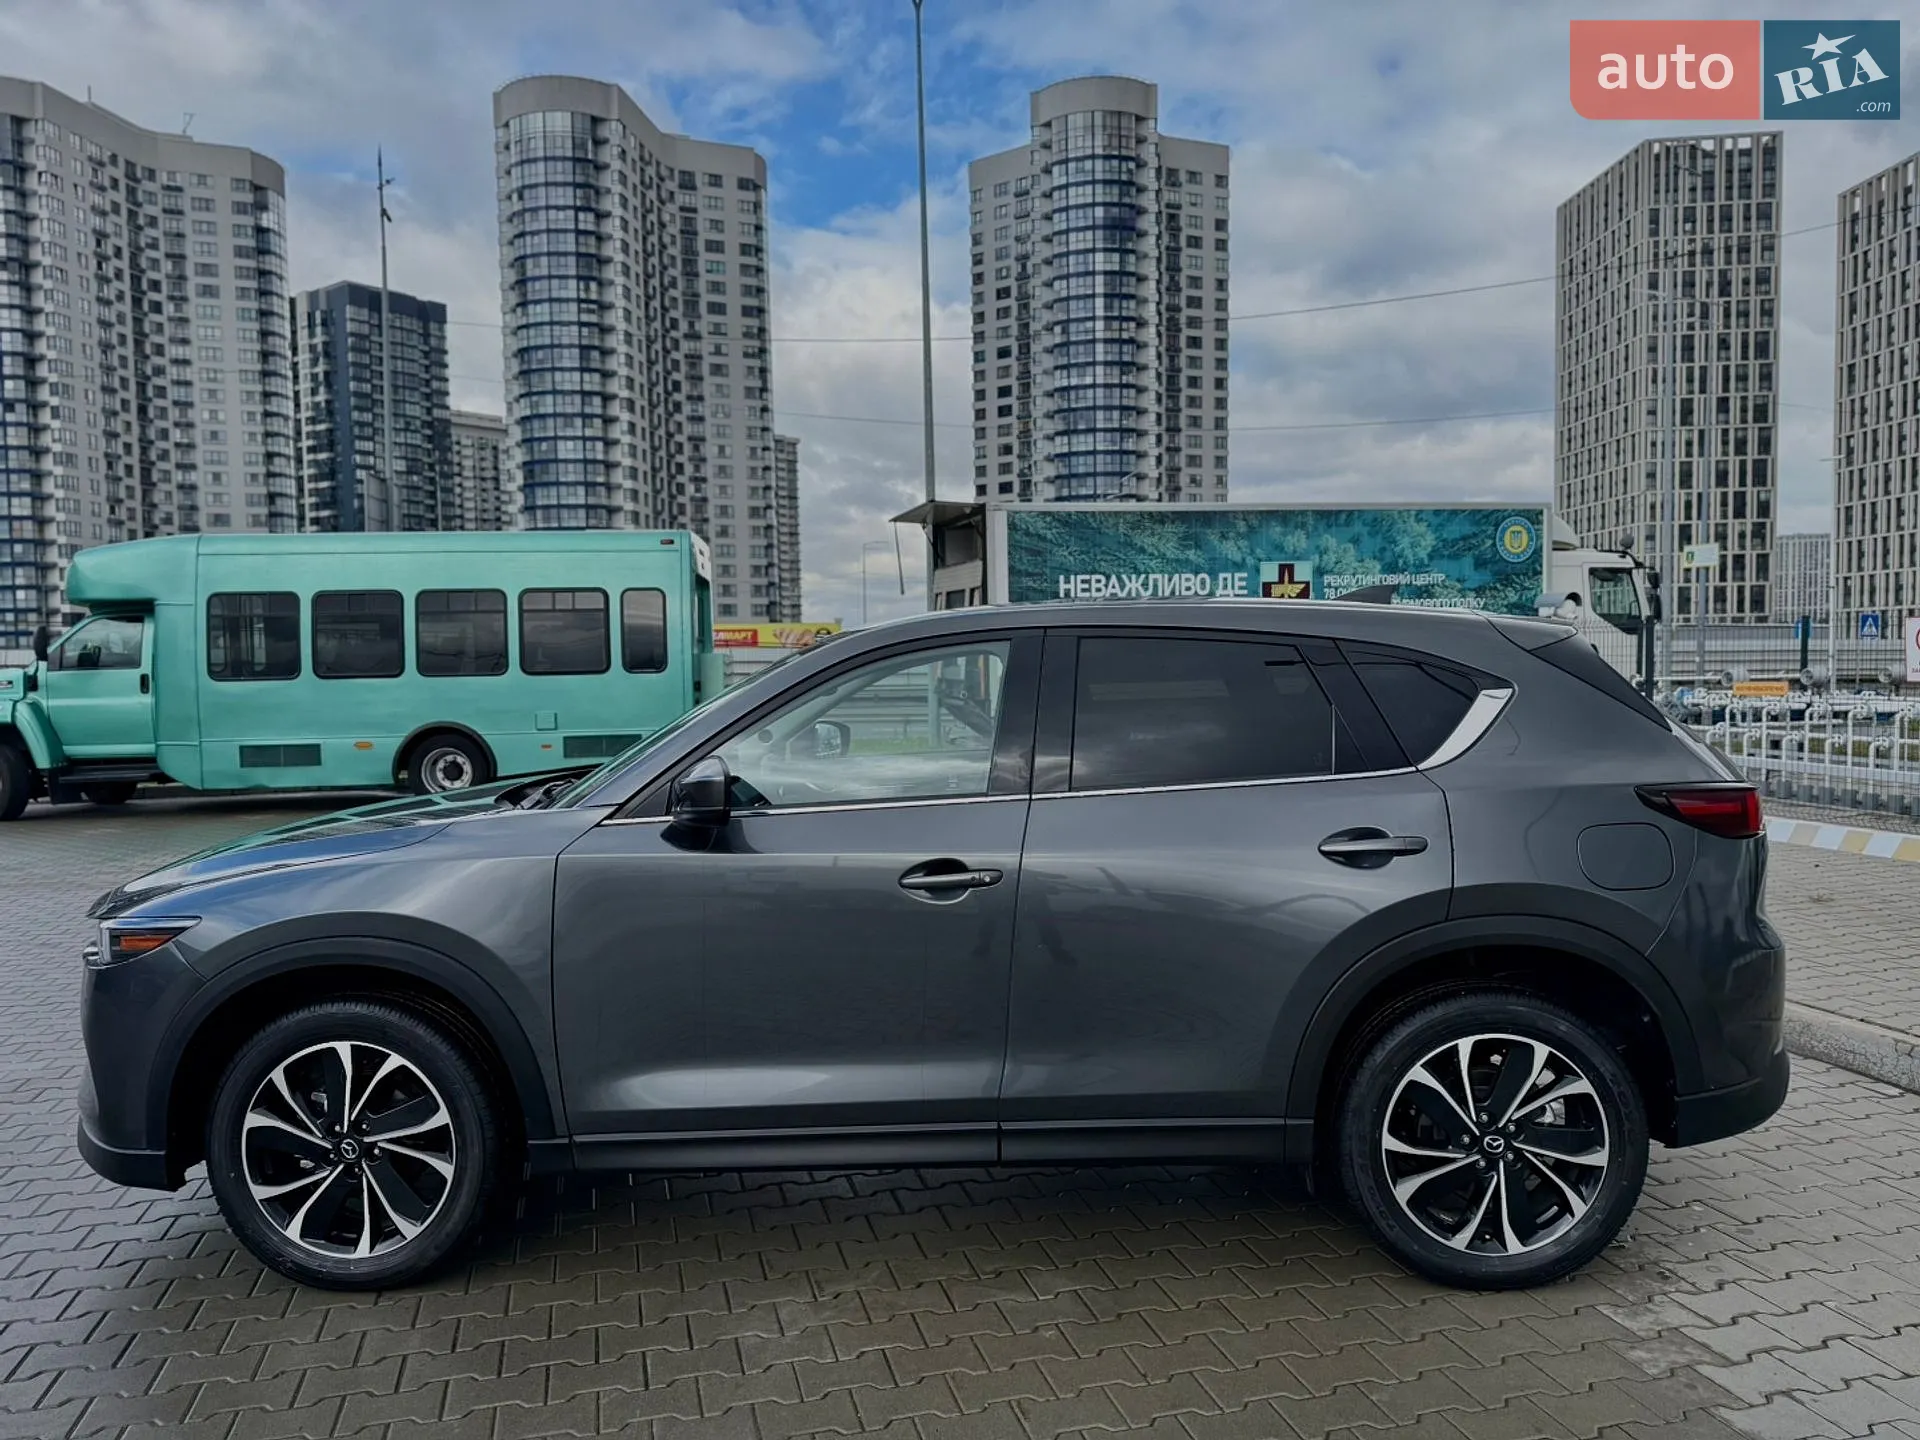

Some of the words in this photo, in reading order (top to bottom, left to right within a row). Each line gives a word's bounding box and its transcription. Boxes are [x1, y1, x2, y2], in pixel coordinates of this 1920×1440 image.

[1058, 572, 1211, 598] НЕВАЖЛИВО
[1215, 572, 1249, 597] ДЕ
[1323, 573, 1411, 587] РЕКРУТИНГОВИЙ
[1412, 573, 1446, 586] ЦЕНТР
